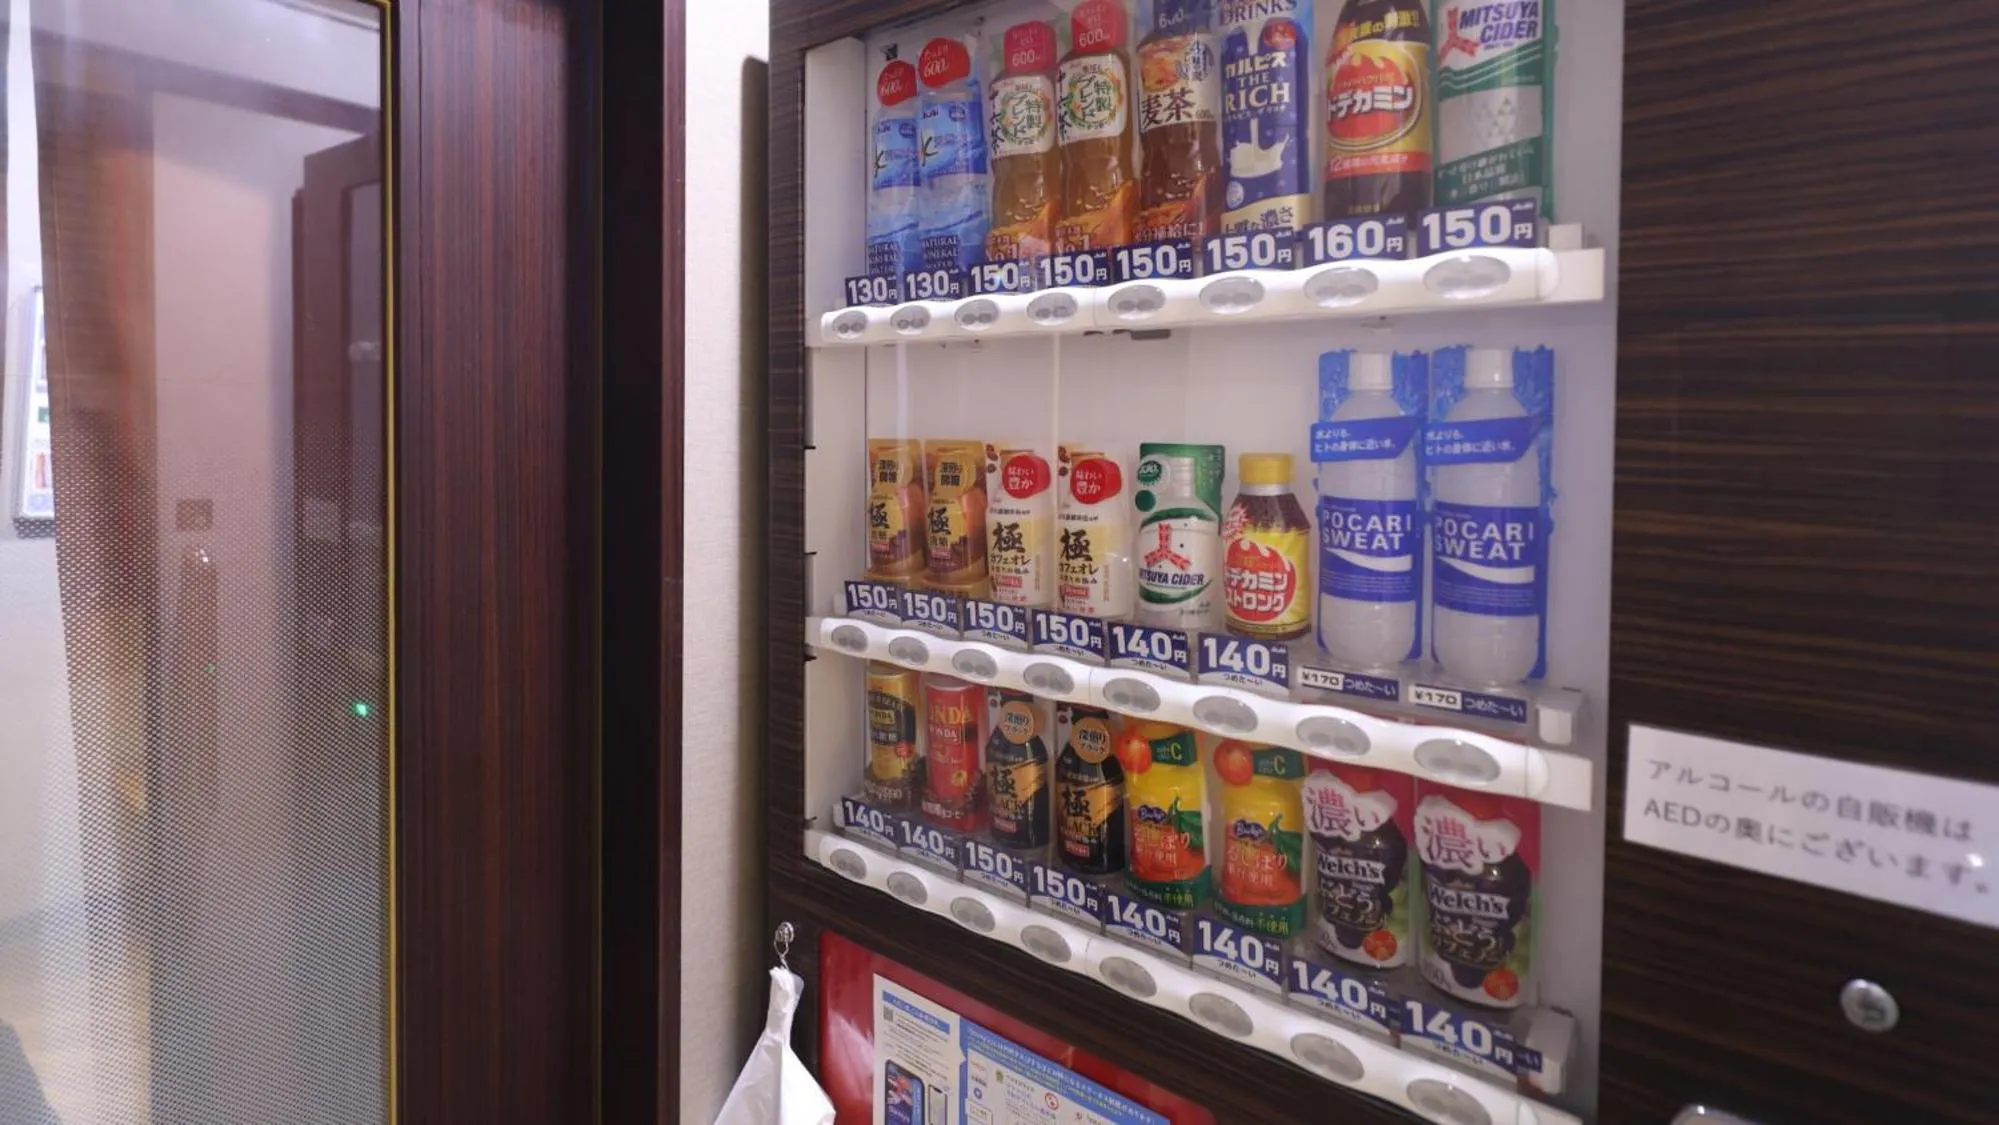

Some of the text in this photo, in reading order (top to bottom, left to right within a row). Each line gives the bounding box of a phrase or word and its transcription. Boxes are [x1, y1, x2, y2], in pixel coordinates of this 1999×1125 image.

[1459, 1, 1539, 30] MITSUYA
[1480, 19, 1538, 44] CIDER
[1225, 51, 1287, 79] カルピス
[1239, 72, 1269, 88] THE
[1141, 87, 1196, 131] 麦茶
[1225, 82, 1290, 114] RICH
[1308, 220, 1403, 261] 160円
[1422, 205, 1533, 249] 150円
[1116, 245, 1192, 280] 150円
[1207, 233, 1292, 271] 150円
[906, 270, 959, 299] 130円
[971, 262, 1031, 294] 150円
[1040, 253, 1107, 287] 150円
[848, 277, 898, 305] 130円
[1008, 477, 1034, 490] 豊か
[1076, 481, 1101, 495] 豊か
[928, 506, 951, 535] 極
[992, 522, 1026, 553] 極
[1323, 509, 1412, 532] POCARI
[1435, 515, 1534, 542] POCARI
[1059, 528, 1093, 562] 極
[1322, 528, 1404, 551] SWEAT
[1435, 535, 1525, 561] SWEAT
[848, 584, 897, 609] 150円
[1171, 573, 1205, 586] CIDER
[1226, 568, 1287, 591] デカミン
[904, 592, 957, 624] 150円
[966, 600, 1025, 634] 150円
[1036, 613, 1102, 649] 150円
[1112, 626, 1187, 663] 140円
[1204, 637, 1286, 679] 140円
[1307, 787, 1380, 835] 濃い
[1647, 759, 1974, 842] アルコールの自販機は
[845, 801, 894, 837] 140円
[901, 821, 955, 858] 140円
[1424, 815, 1506, 869] 濃い
[1643, 797, 1989, 894] AEDの奥にございます。
[966, 842, 1024, 883] 150円
[1033, 866, 1098, 911] 150円
[1430, 885, 1507, 914] Welch's
[1108, 895, 1181, 944] 140円
[1198, 920, 1279, 976] 140円
[1293, 960, 1386, 1019] 140円
[1406, 1001, 1514, 1065] 140円
